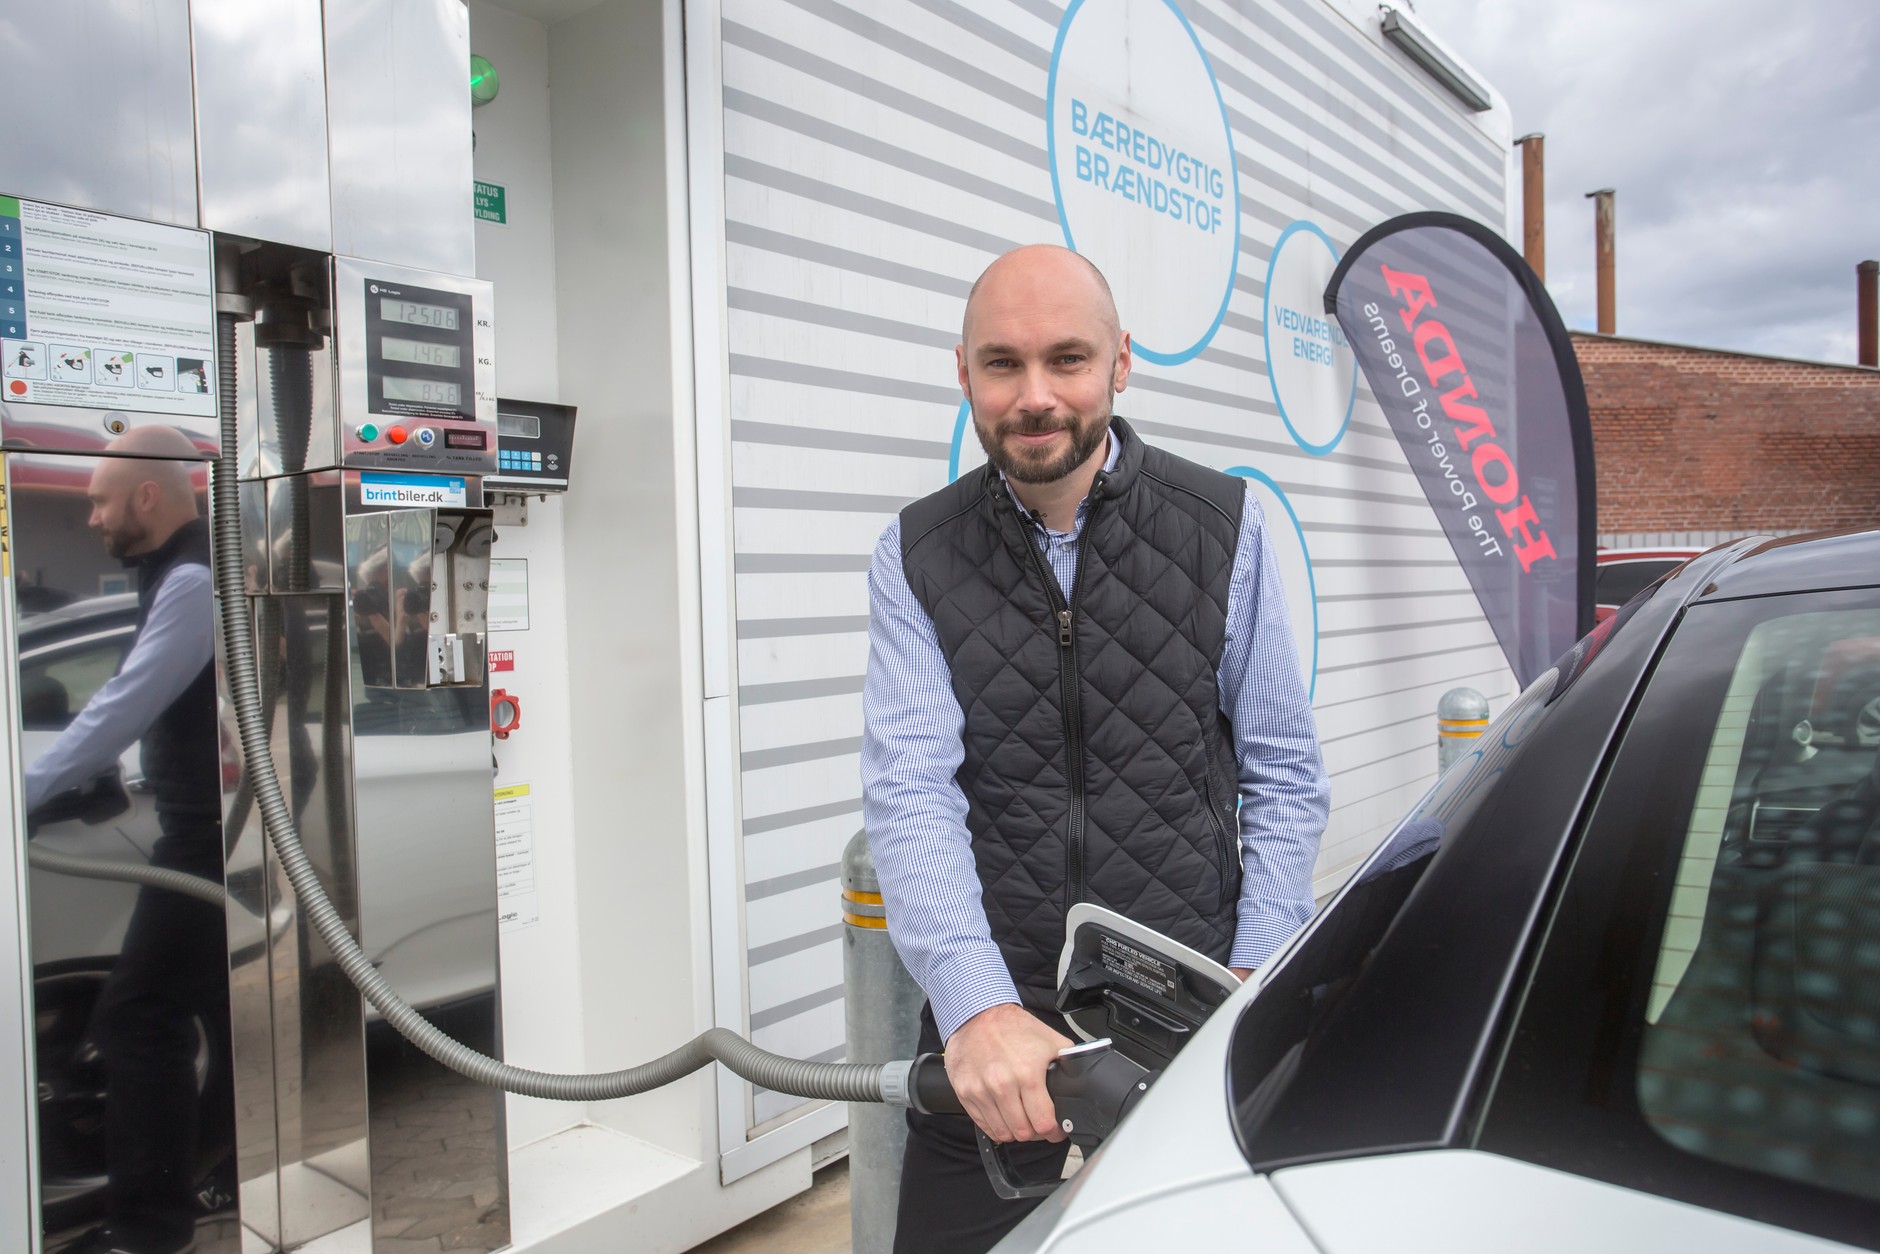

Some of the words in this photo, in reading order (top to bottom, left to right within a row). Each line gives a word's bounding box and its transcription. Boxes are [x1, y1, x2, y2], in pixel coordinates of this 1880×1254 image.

[1072, 98, 1224, 199] BÆREDYGTIG
[1076, 144, 1222, 235] BRÆNDSTOF
[476, 196, 489, 207] LYS
[400, 304, 454, 327] 125.06
[478, 320, 490, 328] KR.
[1294, 337, 1334, 367] ENERGI
[366, 488, 443, 502] brintbiler.dk
[489, 652, 512, 662] TATION
[499, 912, 518, 921] ogic
